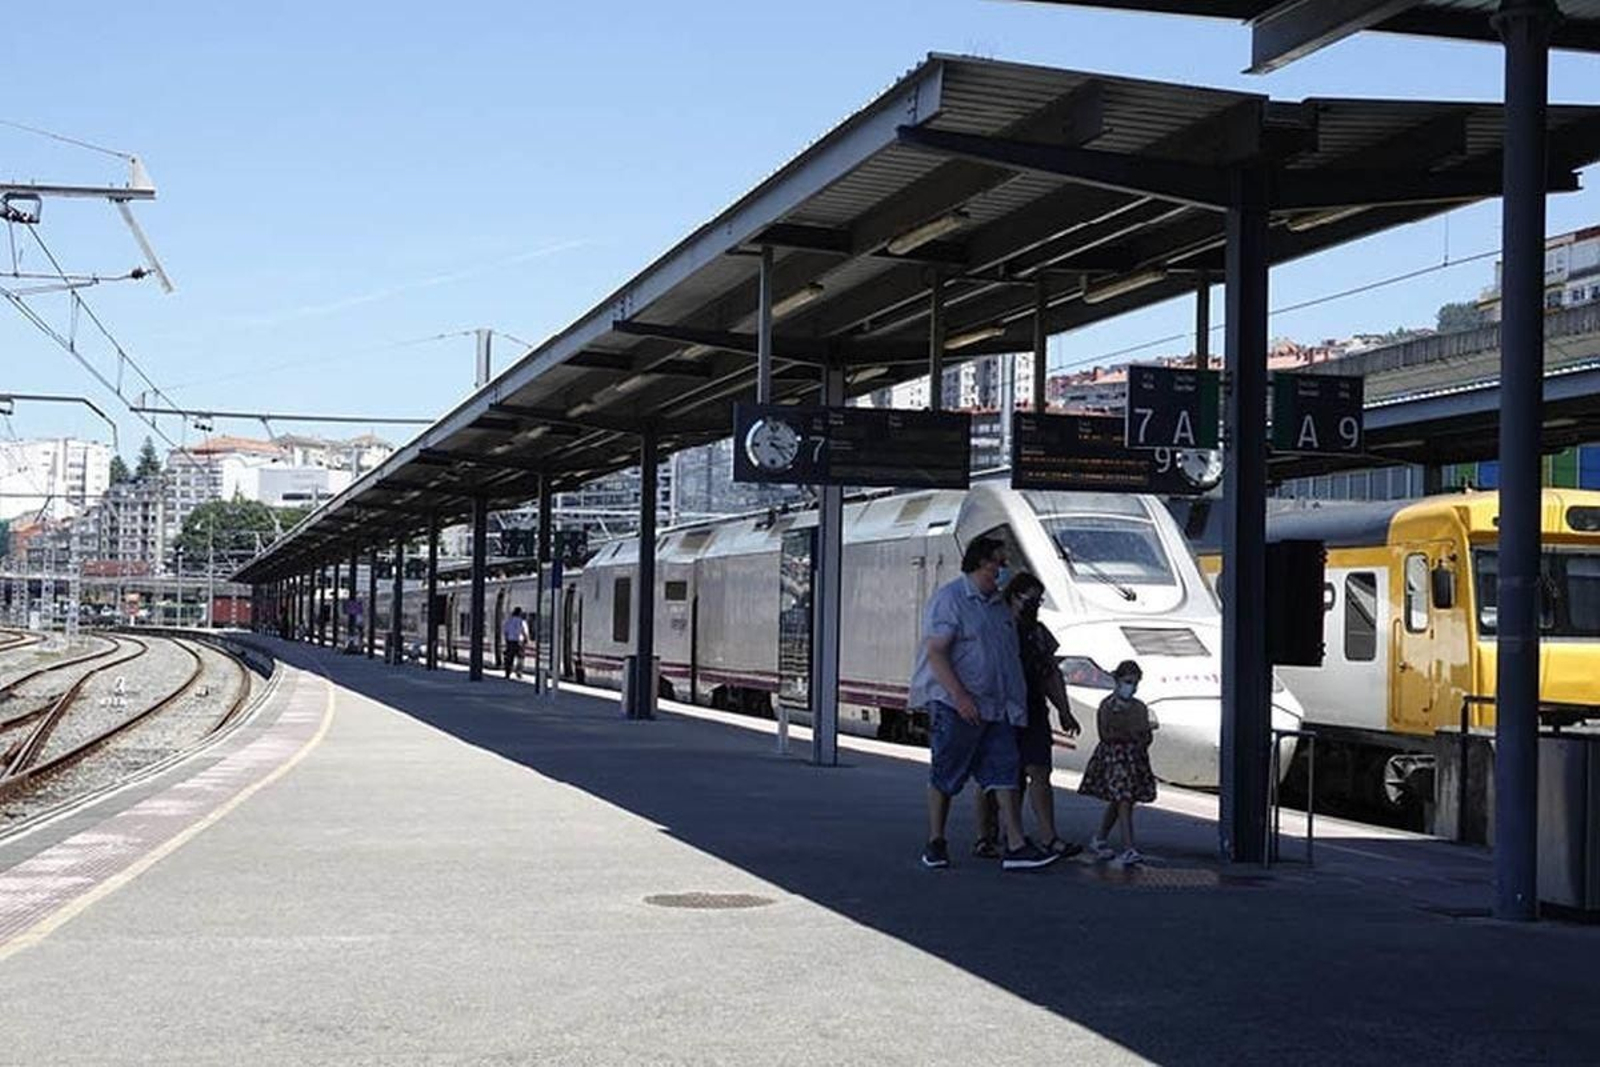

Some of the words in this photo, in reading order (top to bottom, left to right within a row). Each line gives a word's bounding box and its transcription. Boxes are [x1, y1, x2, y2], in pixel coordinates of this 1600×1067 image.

[1134, 408, 1153, 443] 7
[1173, 410, 1195, 445] A
[1297, 414, 1318, 448] A
[1339, 416, 1359, 448] 9
[809, 435, 825, 463] 7
[1154, 447, 1171, 473] 9
